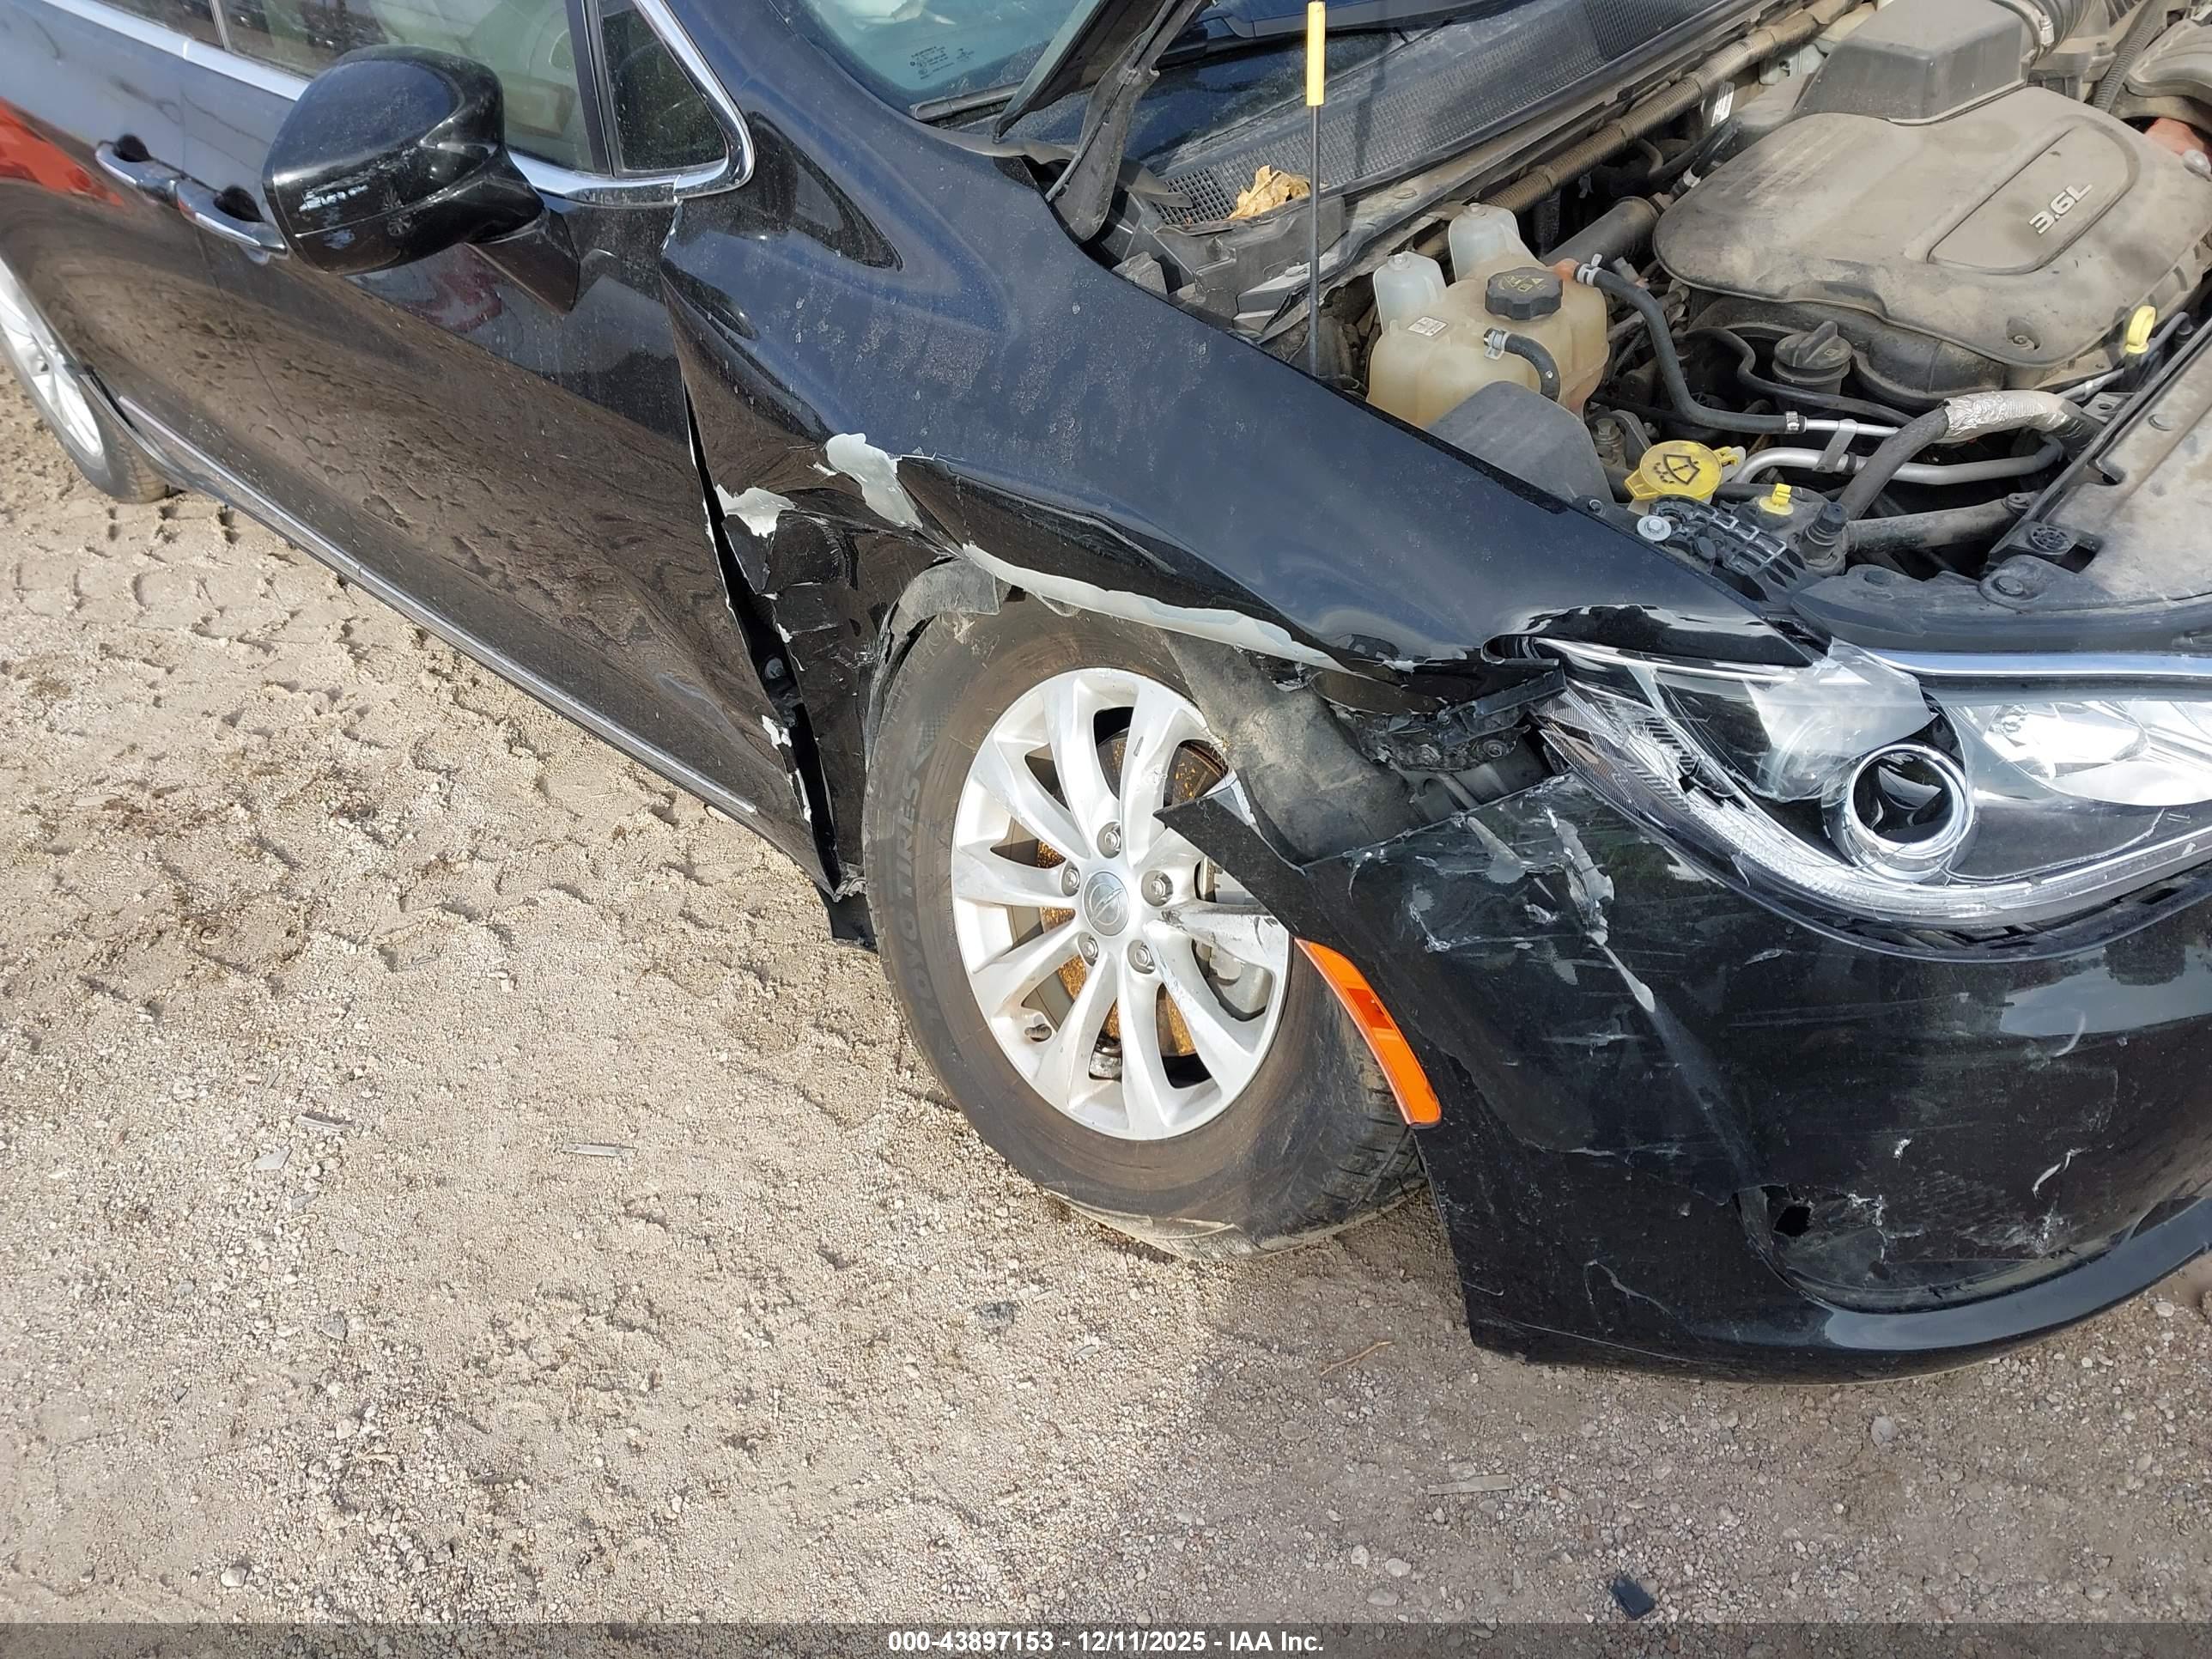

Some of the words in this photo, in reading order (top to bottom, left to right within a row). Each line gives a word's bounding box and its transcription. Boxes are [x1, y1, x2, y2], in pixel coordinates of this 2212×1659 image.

[2028, 183, 2094, 234] 3.6L
[896, 768, 921, 899] TIRES
[897, 908, 941, 1021] TOYO
